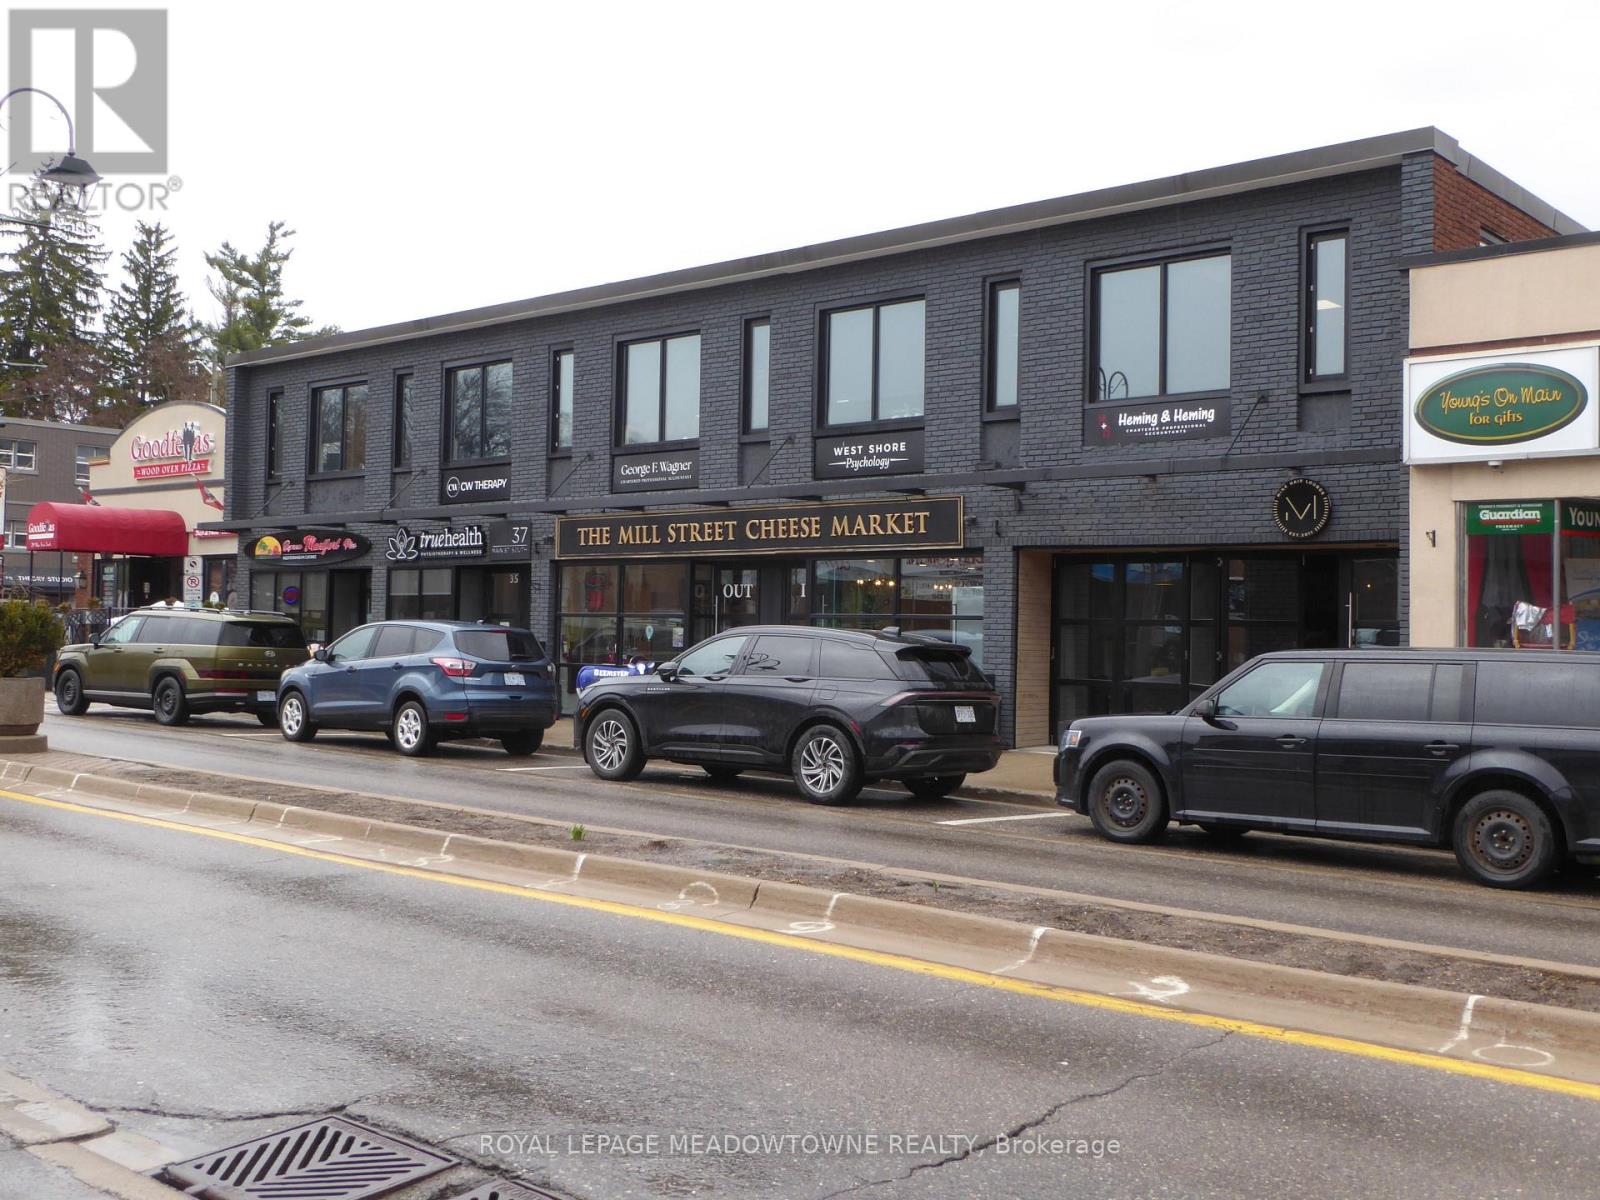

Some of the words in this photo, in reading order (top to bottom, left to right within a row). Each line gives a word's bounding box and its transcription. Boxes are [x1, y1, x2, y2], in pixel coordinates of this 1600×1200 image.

[1440, 390, 1490, 414] Young's
[1494, 387, 1518, 407] On
[1521, 386, 1562, 404] Main
[1118, 411, 1158, 426] Heming
[1161, 409, 1171, 423] &
[1174, 407, 1215, 422] Heming
[1494, 409, 1523, 426] gifts
[833, 445, 863, 456] WEST
[868, 442, 906, 454] SHORE
[140, 466, 160, 476] WOOD
[161, 465, 179, 474] OVEN
[181, 463, 201, 473] PIZZA
[621, 464, 651, 477] George
[652, 461, 659, 473] F.
[660, 461, 692, 475] Wagner
[846, 455, 890, 471] Psychology
[460, 481, 474, 491] CW
[474, 478, 508, 490] THERAPY
[1479, 509, 1541, 520] Guardian
[511, 526, 528, 544] 37
[577, 526, 611, 546] THE
[617, 525, 661, 545] MILL
[667, 520, 737, 543] STREET
[745, 516, 821, 540] CHEESE
[830, 511, 931, 537] MARKET
[420, 526, 483, 548] truehealth
[509, 573, 519, 584] 35
[722, 583, 753, 598] OUT
